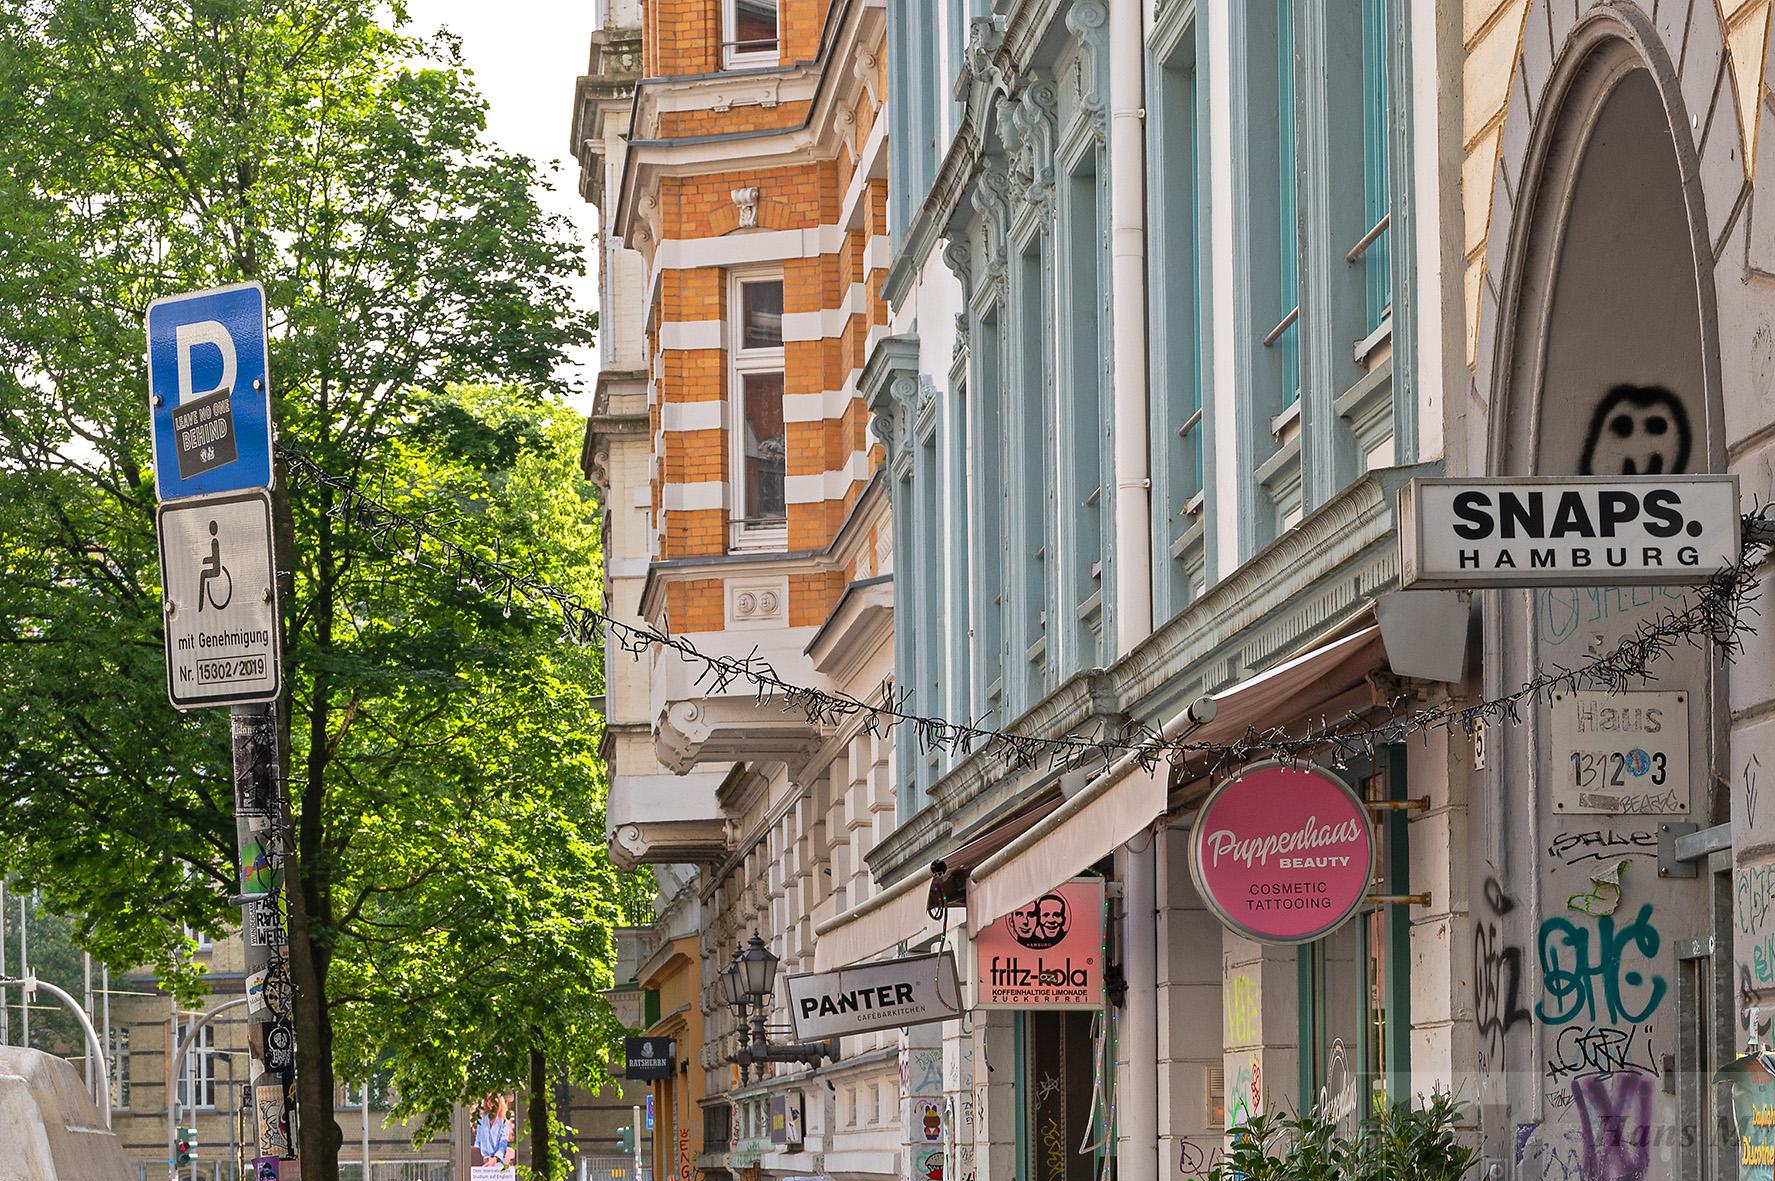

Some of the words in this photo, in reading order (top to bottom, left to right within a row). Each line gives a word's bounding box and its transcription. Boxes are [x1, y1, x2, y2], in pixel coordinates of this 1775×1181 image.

[175, 410, 199, 431] LEAVE
[199, 404, 212, 421] NO
[212, 398, 231, 417] ONE
[182, 418, 229, 452] BEHIND
[1452, 489, 1703, 541] SNAPS.
[1458, 546, 1699, 569] HAMBURG
[178, 633, 195, 650] mit
[199, 629, 269, 649] Genehmigung
[180, 665, 194, 682] Nr.
[199, 658, 264, 681] 15302/2019
[1576, 700, 1664, 733] Haus
[1207, 815, 1362, 869] Puppenhaus
[1279, 856, 1351, 869] BEAUTY
[1249, 881, 1327, 896] COSMETIC
[1246, 897, 1331, 911] TATTOOING
[800, 982, 915, 1019] PANTER
[629, 1058, 667, 1067] RATSHERRN
